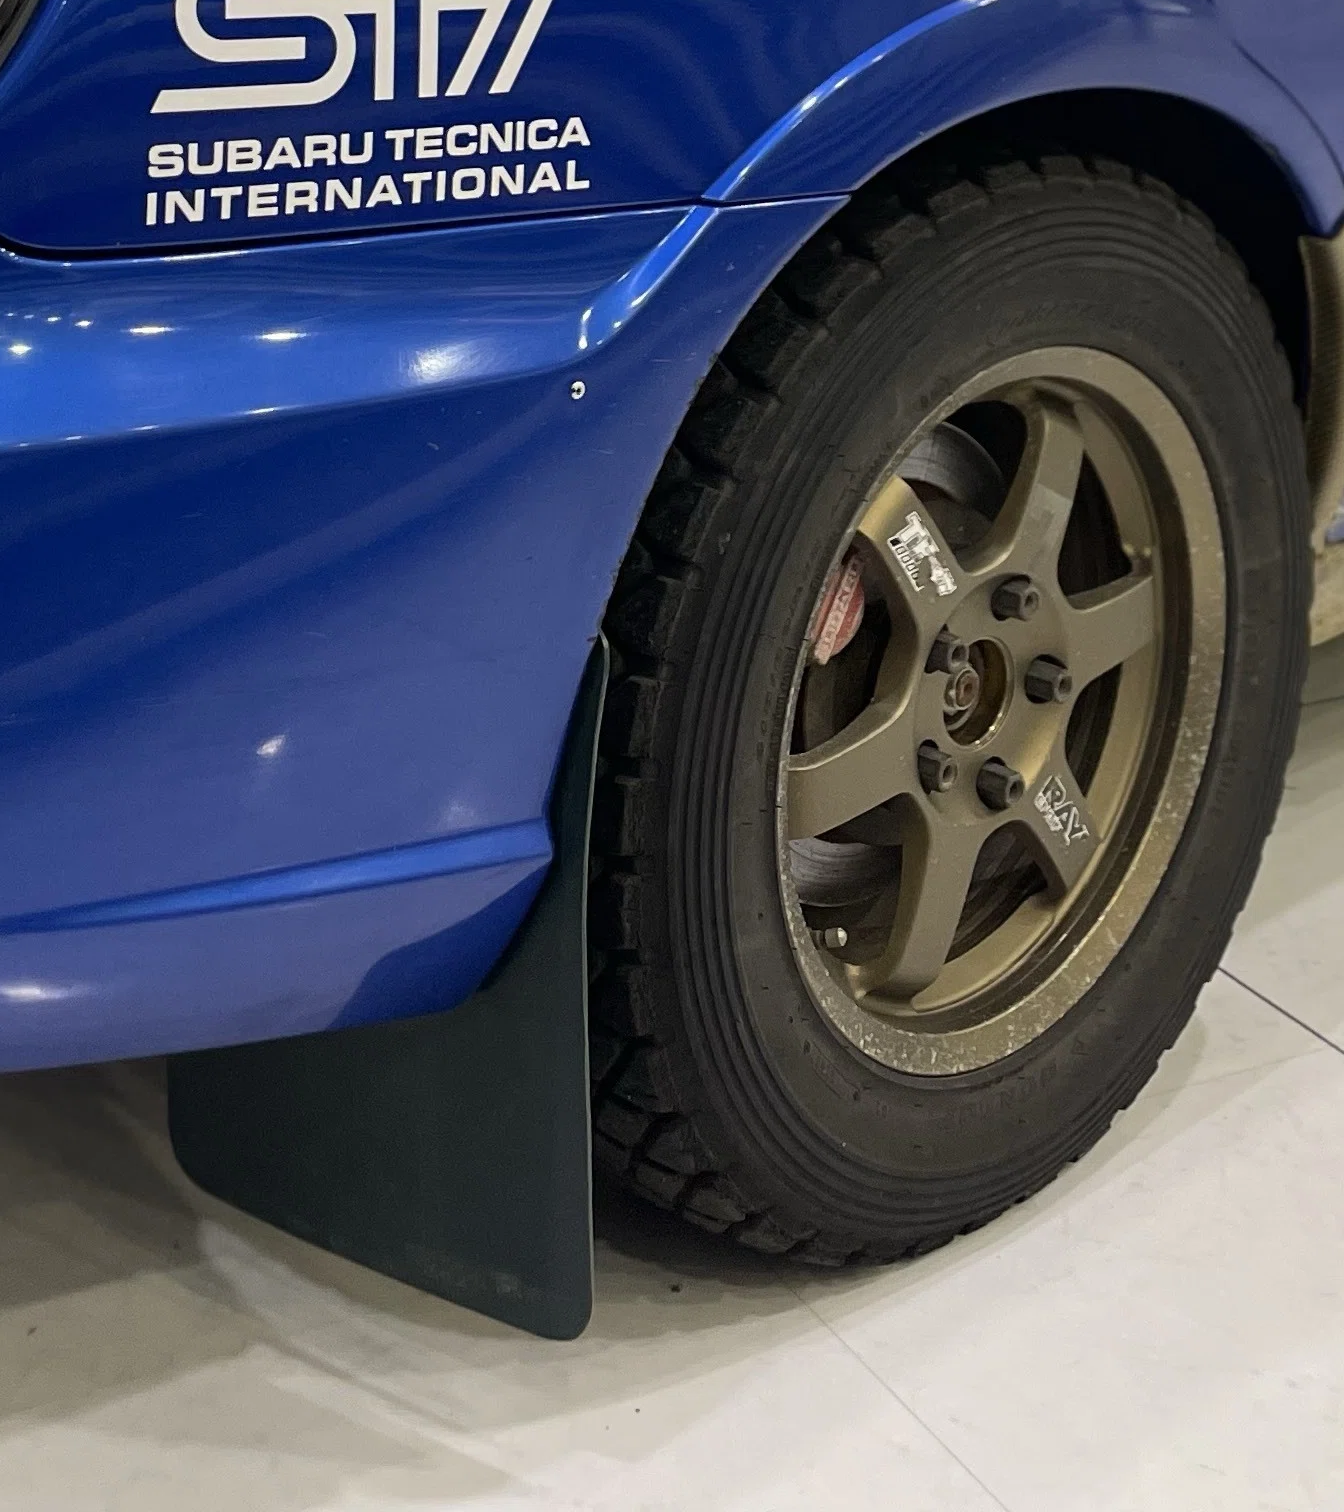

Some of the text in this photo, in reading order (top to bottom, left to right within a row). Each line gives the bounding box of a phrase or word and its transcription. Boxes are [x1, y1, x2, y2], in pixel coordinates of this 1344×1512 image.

[148, 116, 590, 178] SUBARU TECNICA
[145, 160, 590, 226] INTERNATIONAL
